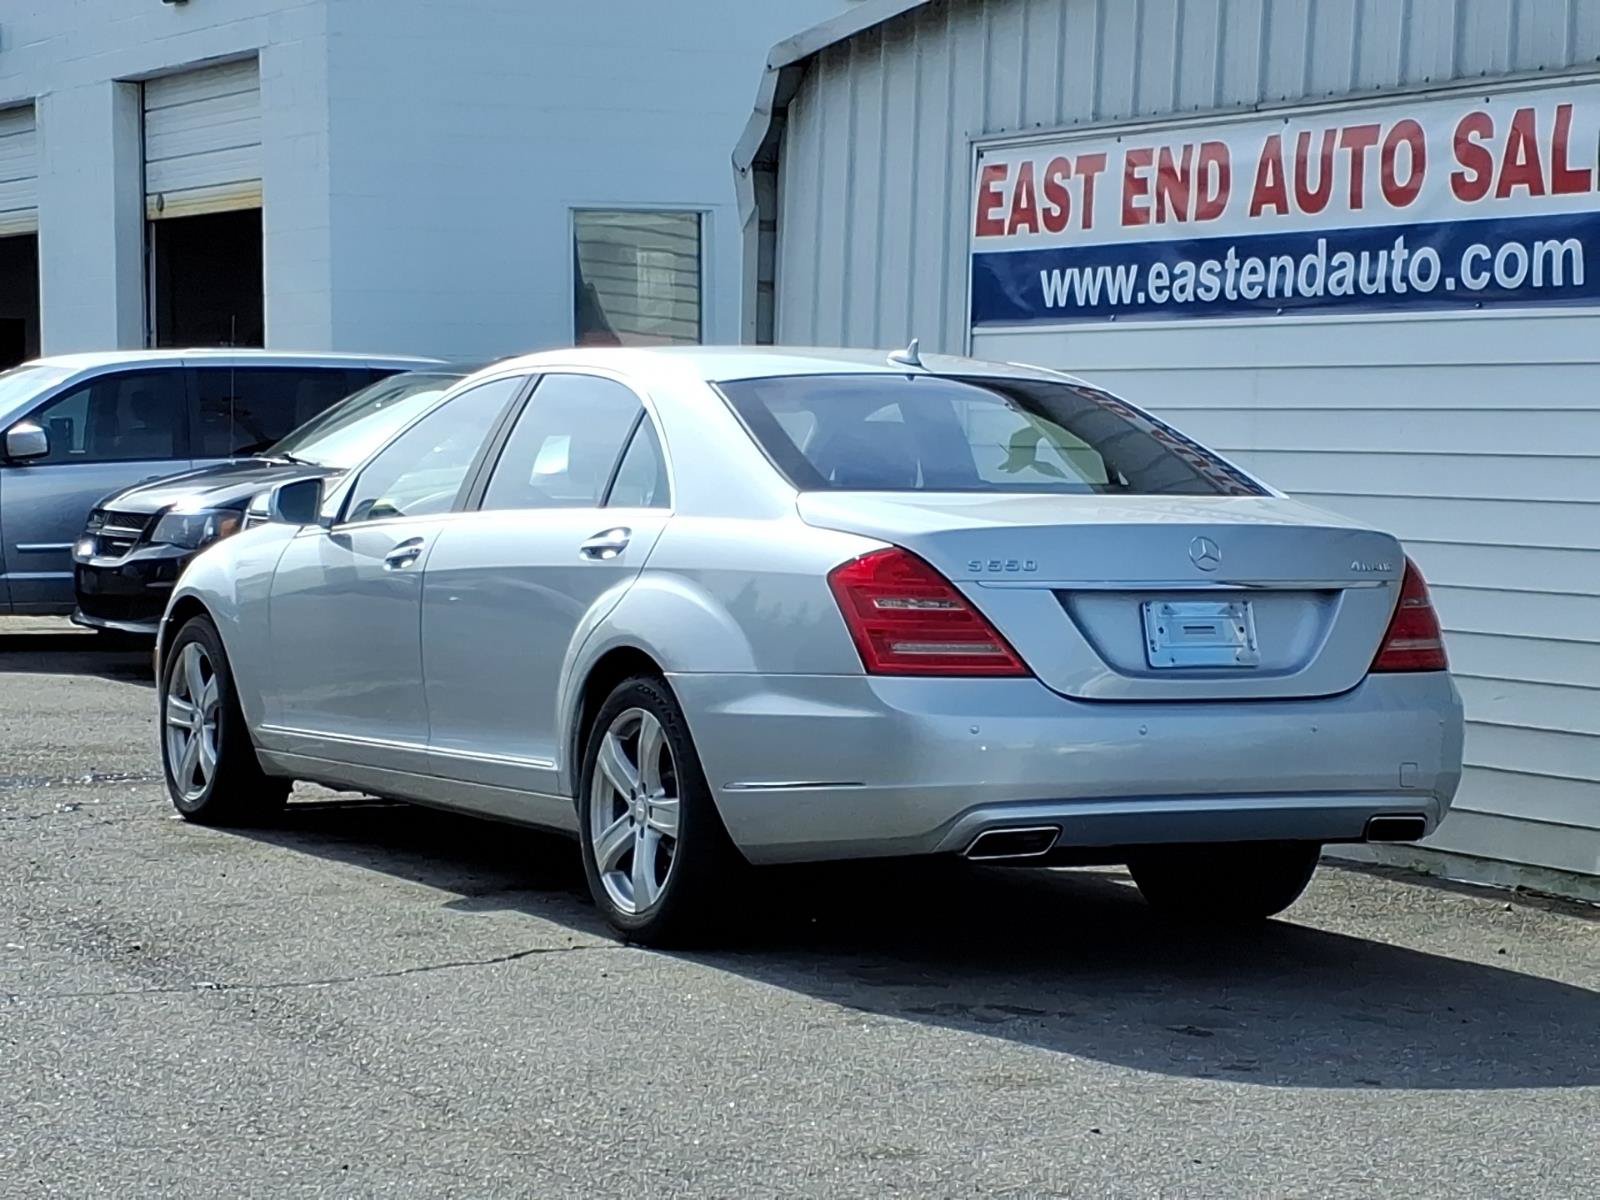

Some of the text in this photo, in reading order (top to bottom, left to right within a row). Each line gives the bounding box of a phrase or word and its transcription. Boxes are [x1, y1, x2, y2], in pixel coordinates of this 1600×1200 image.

[974, 103, 1600, 237] EAST END AUTO SAL
[1041, 235, 1584, 308] www.eastendauto.com
